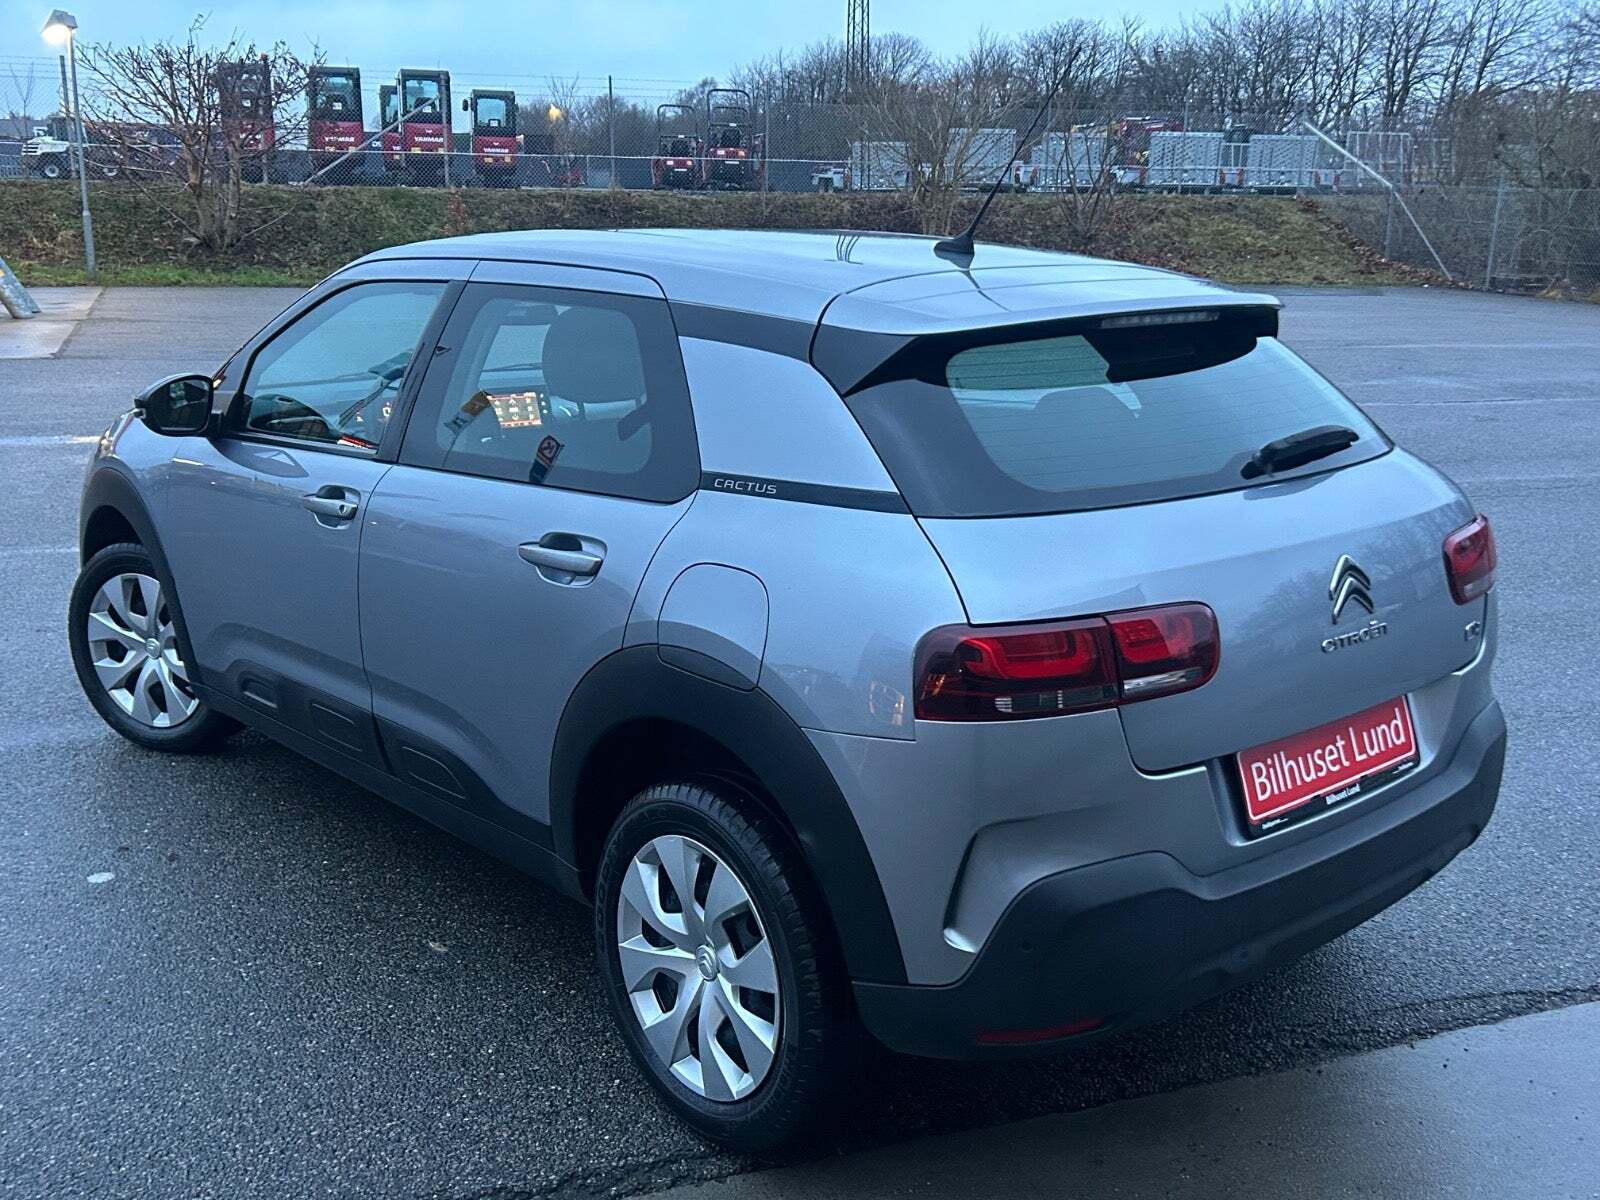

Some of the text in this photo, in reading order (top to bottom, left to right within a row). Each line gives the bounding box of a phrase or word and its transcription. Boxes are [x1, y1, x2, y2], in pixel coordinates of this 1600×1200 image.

[714, 478, 777, 494] CACTUS
[1250, 707, 1406, 801] Bilhuset Lund
